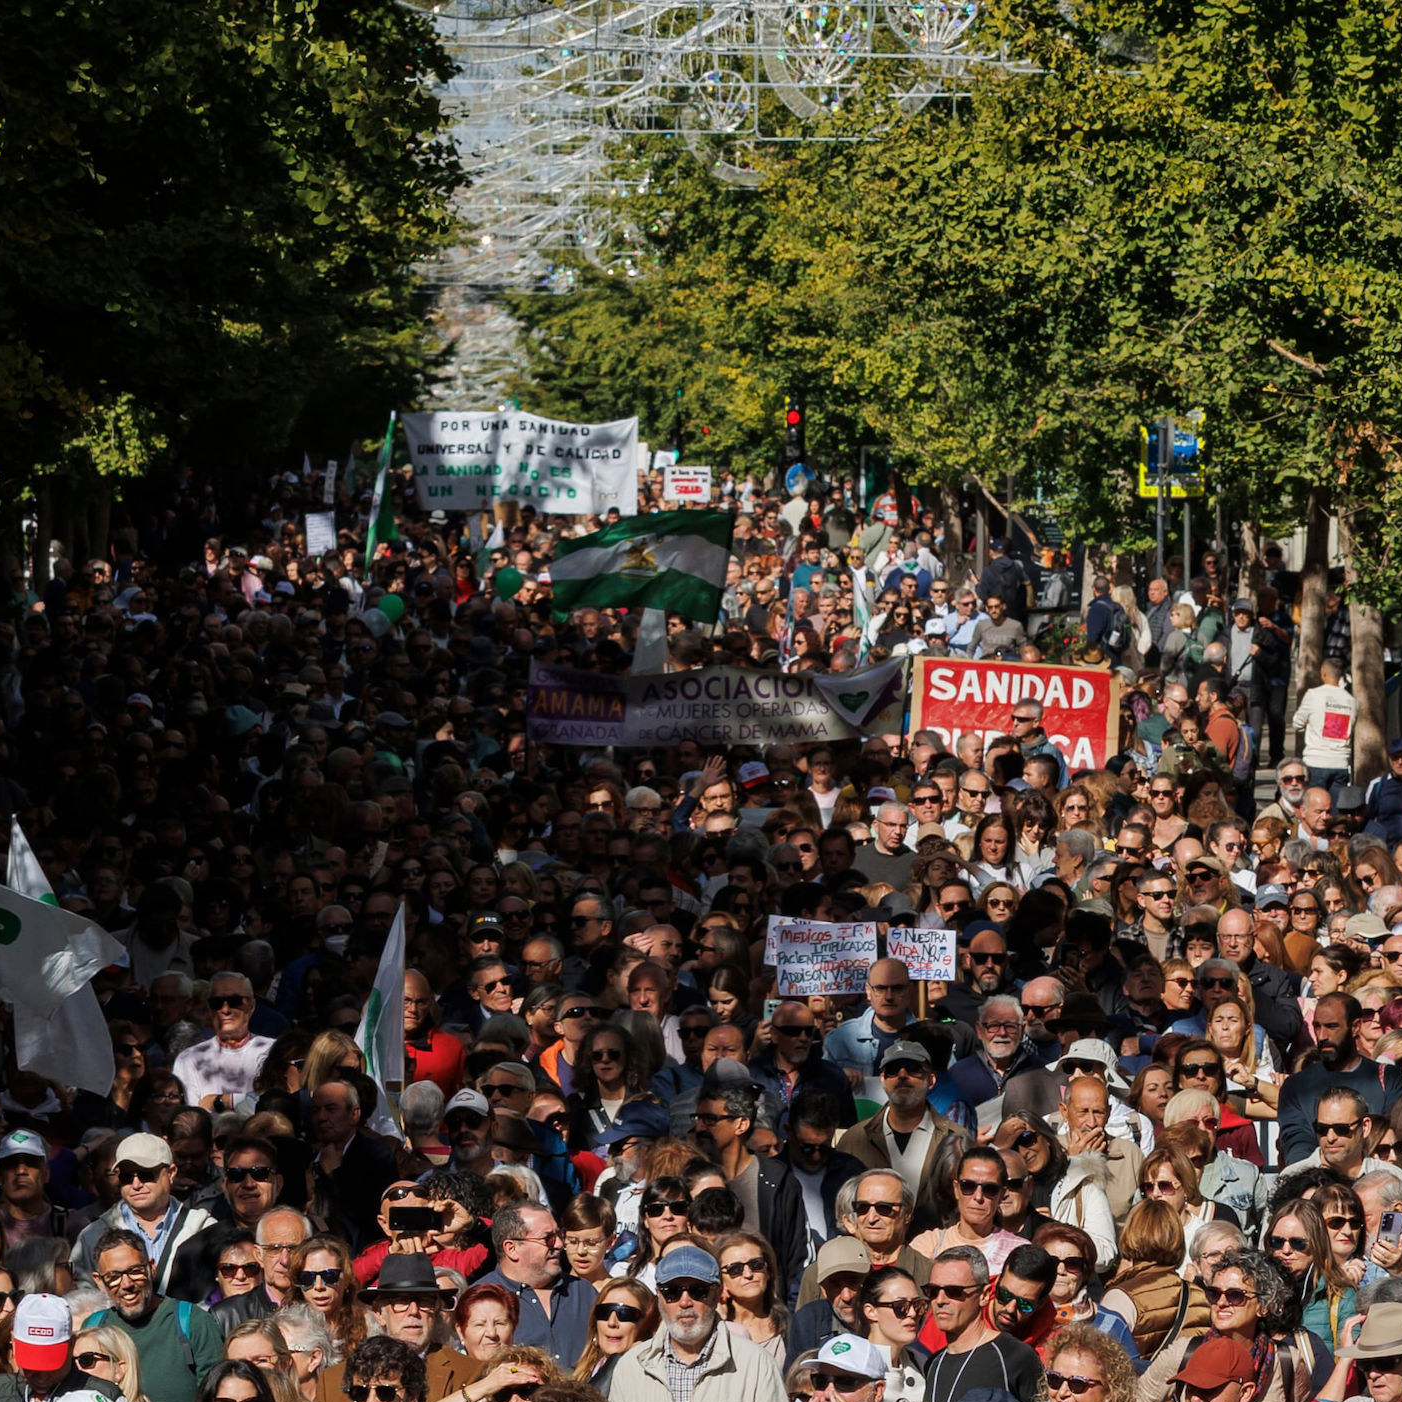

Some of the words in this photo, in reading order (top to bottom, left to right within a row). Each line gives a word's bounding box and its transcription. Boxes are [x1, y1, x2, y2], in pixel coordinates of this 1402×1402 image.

[441, 420, 471, 432] POR
[481, 419, 510, 432] UNA
[519, 420, 591, 437] SANIDAD
[417, 444, 493, 456] UNIVERSAL
[503, 444, 511, 456] Y
[525, 444, 546, 456] DE
[554, 446, 622, 460] CALIDAD
[435, 464, 502, 477] SANIDAD
[549, 466, 573, 479] ES
[427, 485, 453, 497] UN
[475, 484, 578, 499] NEGOCIO
[645, 674, 812, 701] ASOCIACIO
[929, 667, 1095, 710] SANIDAD
[533, 689, 624, 719] AMAMA
[656, 702, 732, 720] MUJERES
[737, 700, 831, 718] OPERADAS
[639, 728, 655, 740] DE
[655, 722, 733, 743] CÁNCER
[737, 724, 762, 740] DE
[767, 722, 829, 739] MAMA
[904, 928, 948, 943] NUESTRA
[922, 943, 938, 957] NO
[28, 1327, 54, 1337] CCOO
